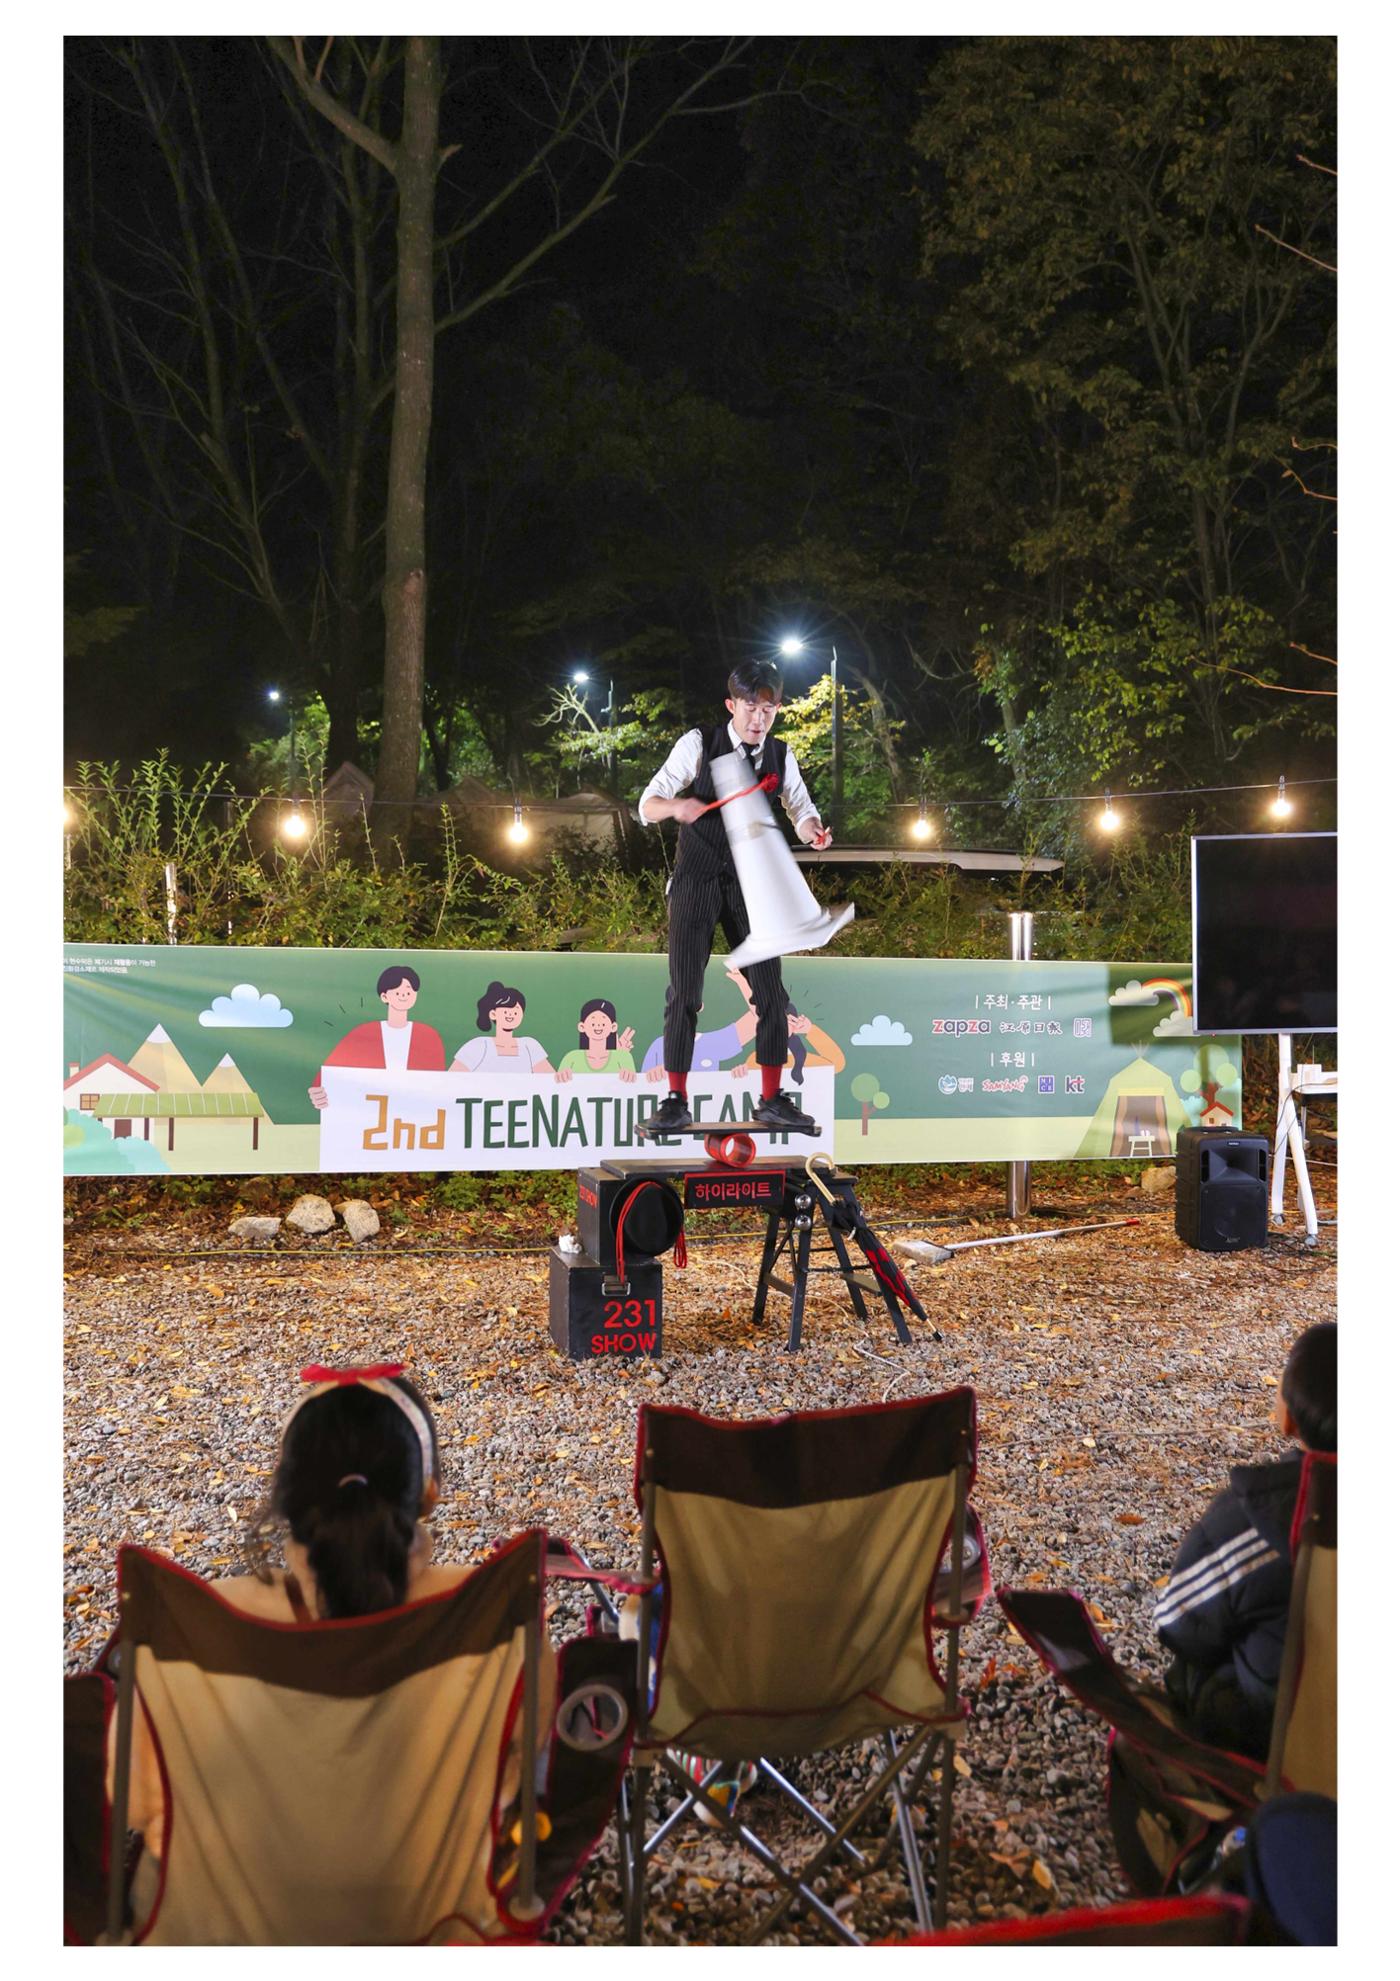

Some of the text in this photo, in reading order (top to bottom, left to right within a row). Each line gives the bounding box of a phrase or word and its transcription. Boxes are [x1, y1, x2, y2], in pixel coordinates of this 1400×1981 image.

[932, 1019, 991, 1037] zapza
[999, 1052, 1025, 1068] 후원
[1066, 1076, 1084, 1093] kt
[363, 1094, 446, 1150] 2nd
[456, 1094, 682, 1149] TEENATUR
[695, 1181, 772, 1201] 하이라이트
[604, 1299, 656, 1329] 231
[591, 1332, 657, 1354] SHOW
